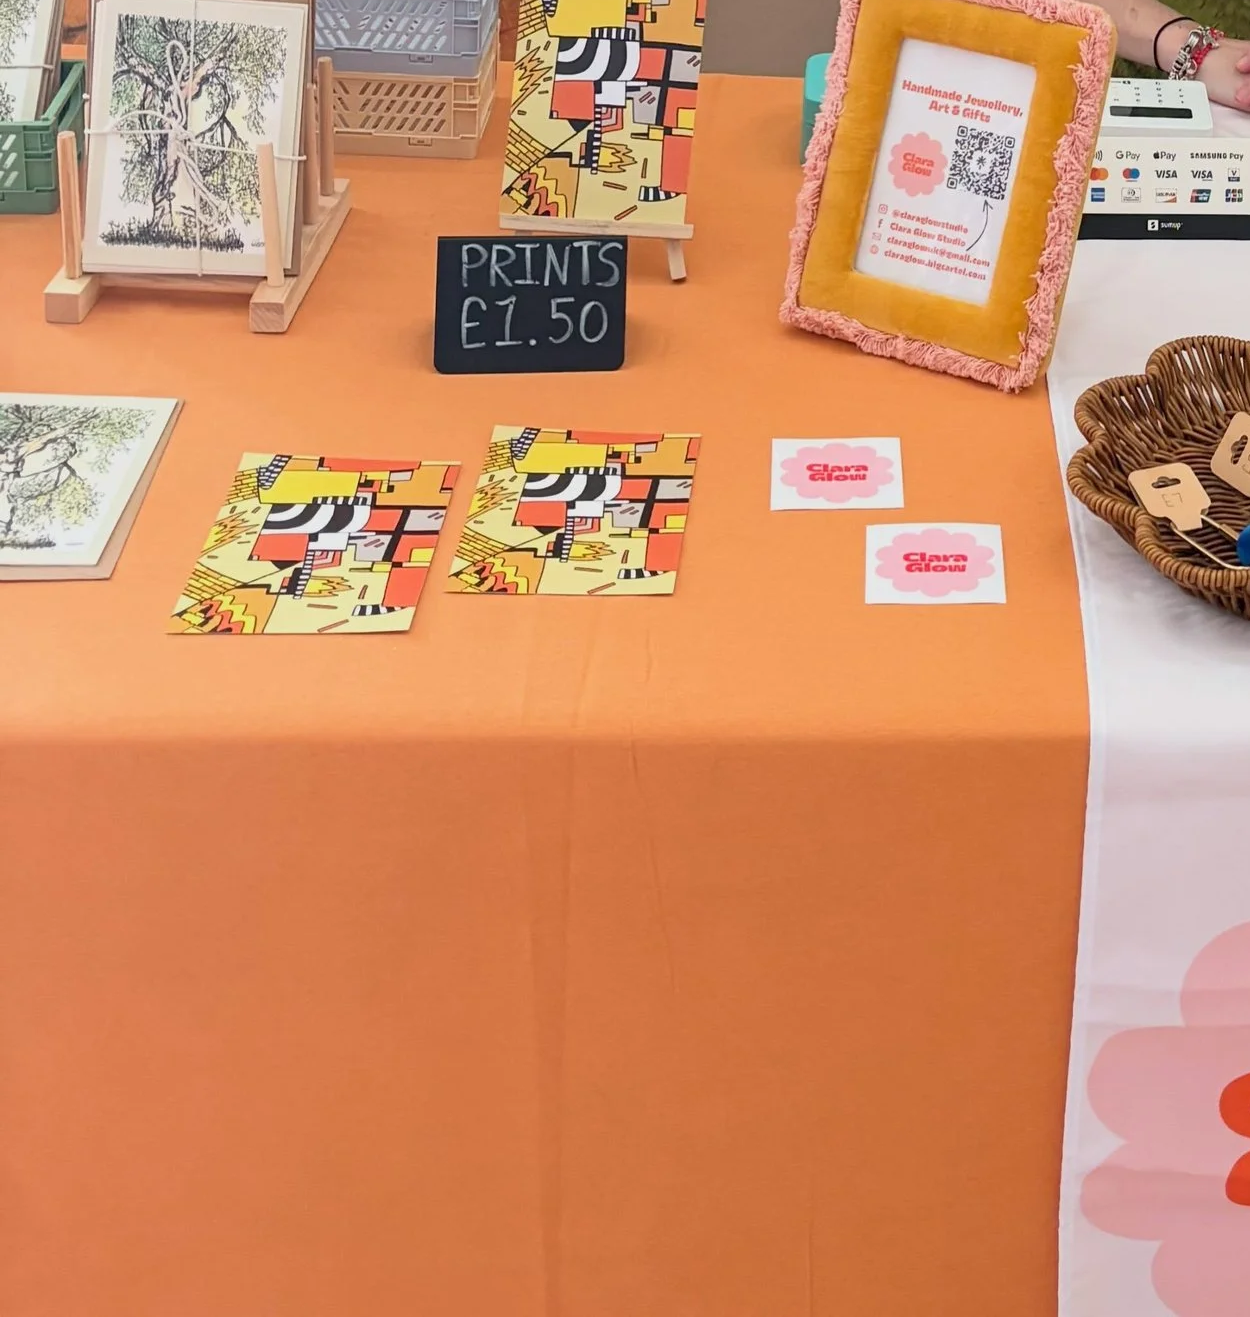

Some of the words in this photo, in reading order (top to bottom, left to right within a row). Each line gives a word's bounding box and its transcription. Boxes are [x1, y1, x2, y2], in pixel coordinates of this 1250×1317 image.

[902, 79, 962, 102] Handmade
[964, 94, 1023, 117] Jewellery,
[929, 100, 949, 114] Art
[951, 105, 960, 116] &
[962, 108, 991, 123] Gifts
[903, 152, 935, 167] Clara
[1125, 151, 1141, 161] Pay
[1161, 151, 1177, 161] Pay
[1190, 152, 1227, 160] SAMSUNG
[1229, 153, 1244, 161] Pay
[902, 163, 932, 177] Glow
[1154, 170, 1178, 179] VISA
[1191, 170, 1213, 179] VISA
[892, 209, 969, 234] @claraglowstudio
[890, 222, 912, 234] Clara
[913, 228, 936, 240] Glow
[936, 234, 967, 247] Studio
[462, 240, 623, 287] PRINTS
[461, 295, 609, 349] £1.50
[806, 463, 869, 472] Clara
[808, 472, 867, 482] Glow
[902, 552, 968, 563] Clara
[905, 563, 967, 573] Glow
